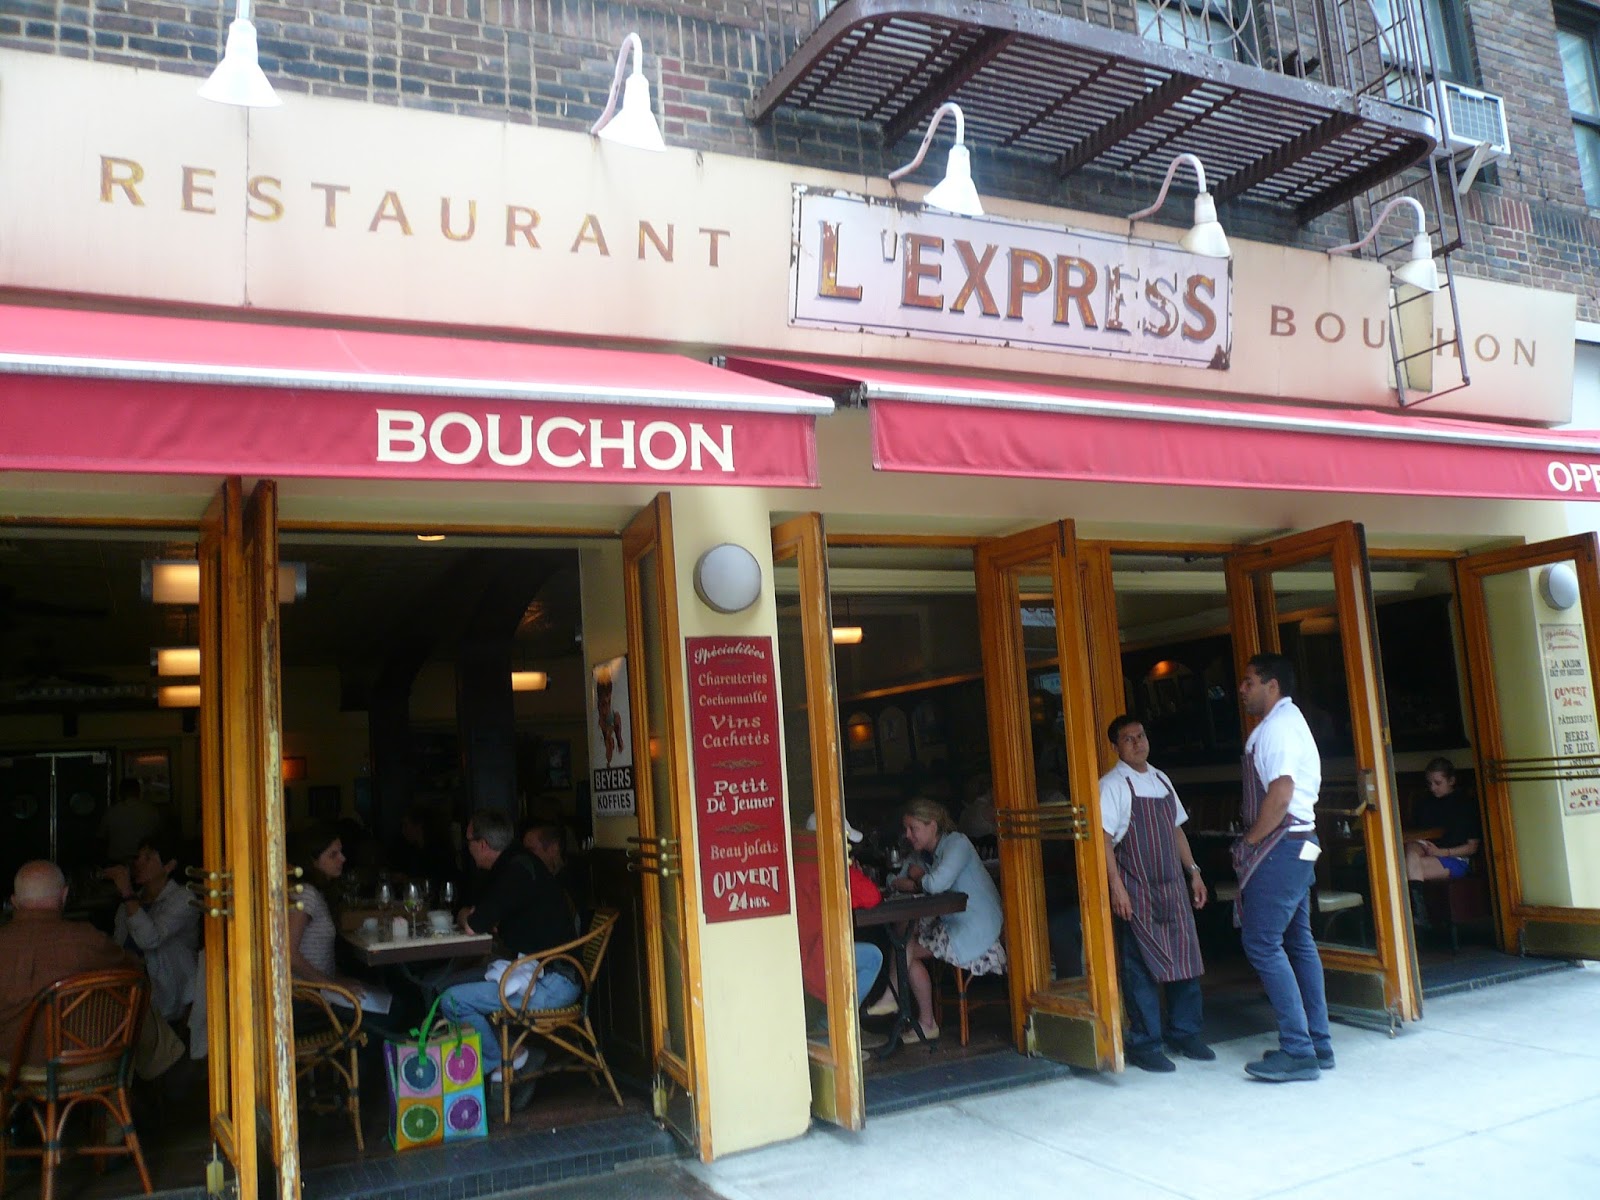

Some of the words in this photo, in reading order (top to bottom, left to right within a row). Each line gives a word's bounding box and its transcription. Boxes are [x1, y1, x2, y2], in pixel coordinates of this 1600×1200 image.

[100, 154, 731, 268] RESTAURANT
[816, 219, 1217, 343] L'EXPRESS
[1270, 304, 1537, 368] BOUHON
[376, 408, 735, 472] BOUCHON
[1554, 686, 1587, 700] OUVERT
[1562, 698, 1572, 707] 24
[709, 714, 762, 730] Vins
[1564, 744, 1574, 755] DE
[1576, 741, 1596, 754] LUXE
[595, 768, 632, 790] BEYERS
[713, 777, 769, 797] Petit
[597, 793, 631, 809] KOFFIES
[706, 796, 727, 813] Dé
[731, 795, 775, 815] Jeuner
[710, 838, 778, 864] Beaujolais
[713, 866, 779, 898] OUVERT
[728, 890, 748, 911] 24
